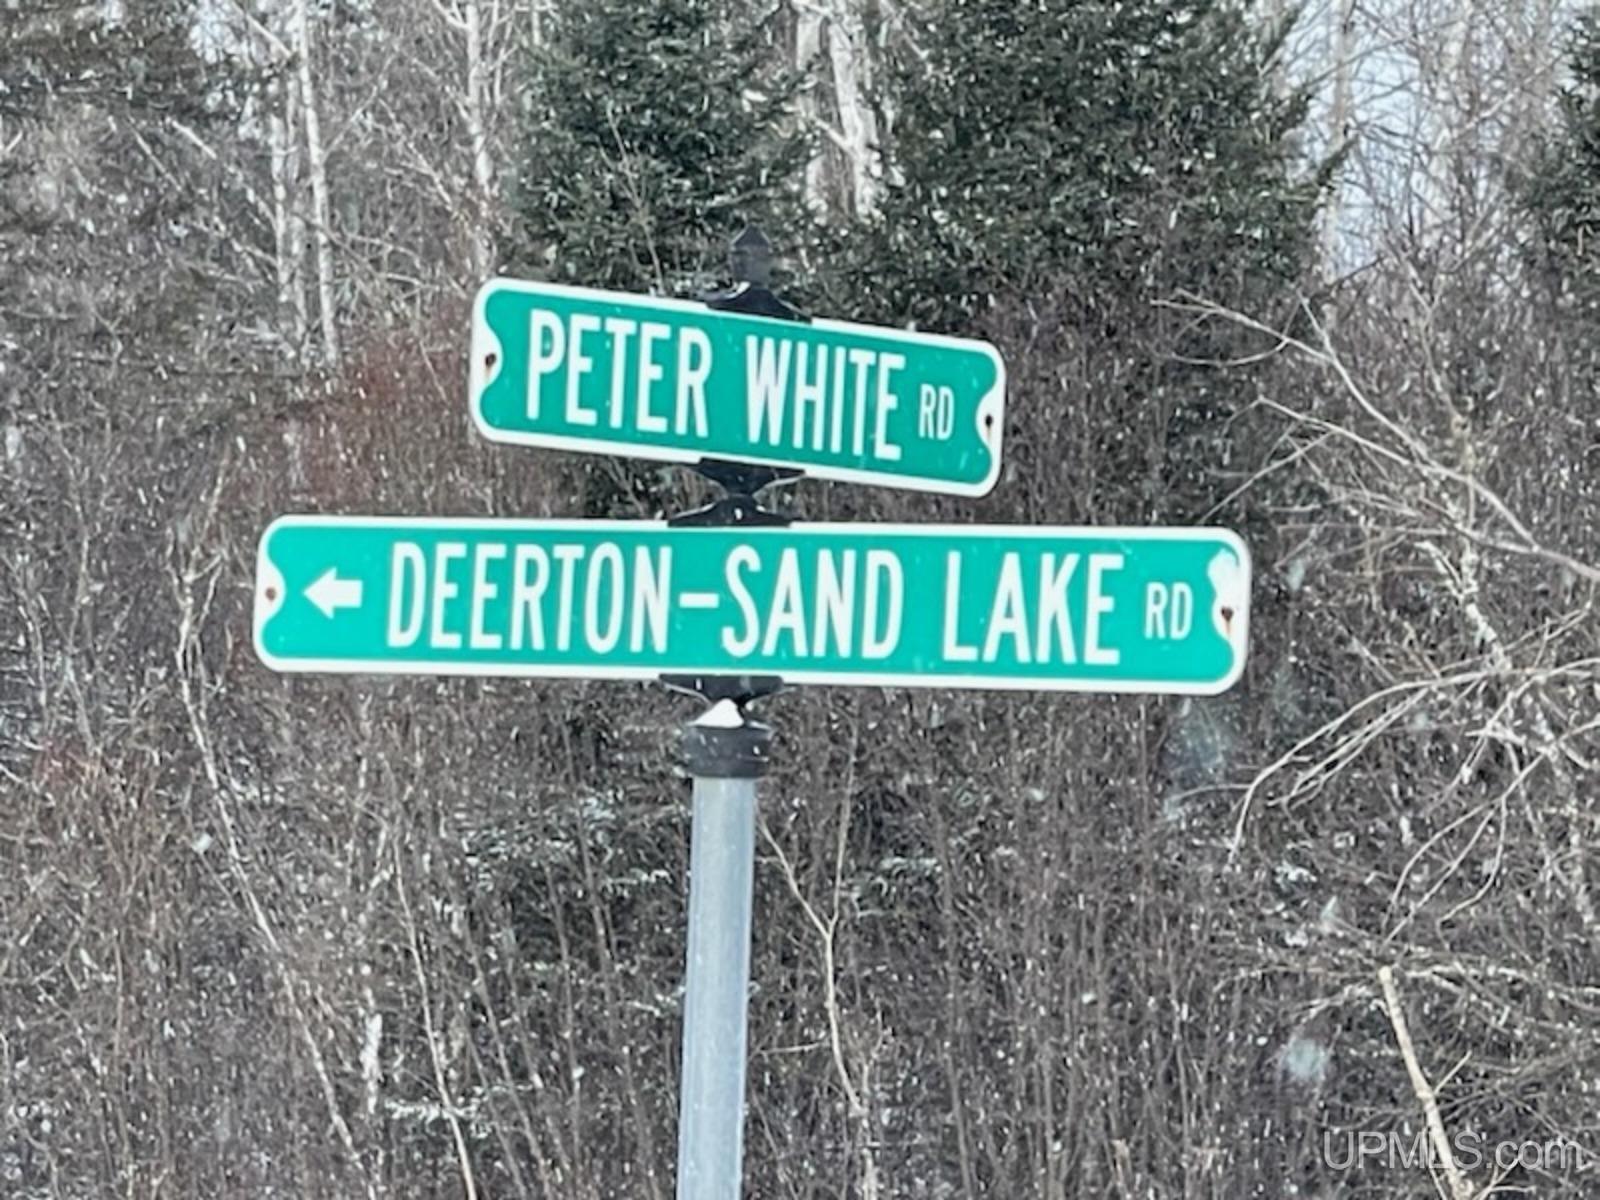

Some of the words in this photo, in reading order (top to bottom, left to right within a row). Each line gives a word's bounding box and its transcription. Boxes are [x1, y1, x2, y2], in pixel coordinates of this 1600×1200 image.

[526, 309, 712, 437] PETER
[746, 335, 906, 461] WHITE
[919, 383, 954, 441] RD
[388, 542, 904, 659] DEERTON-SAND
[943, 551, 1125, 665] LAKE
[1145, 581, 1193, 640] RD
